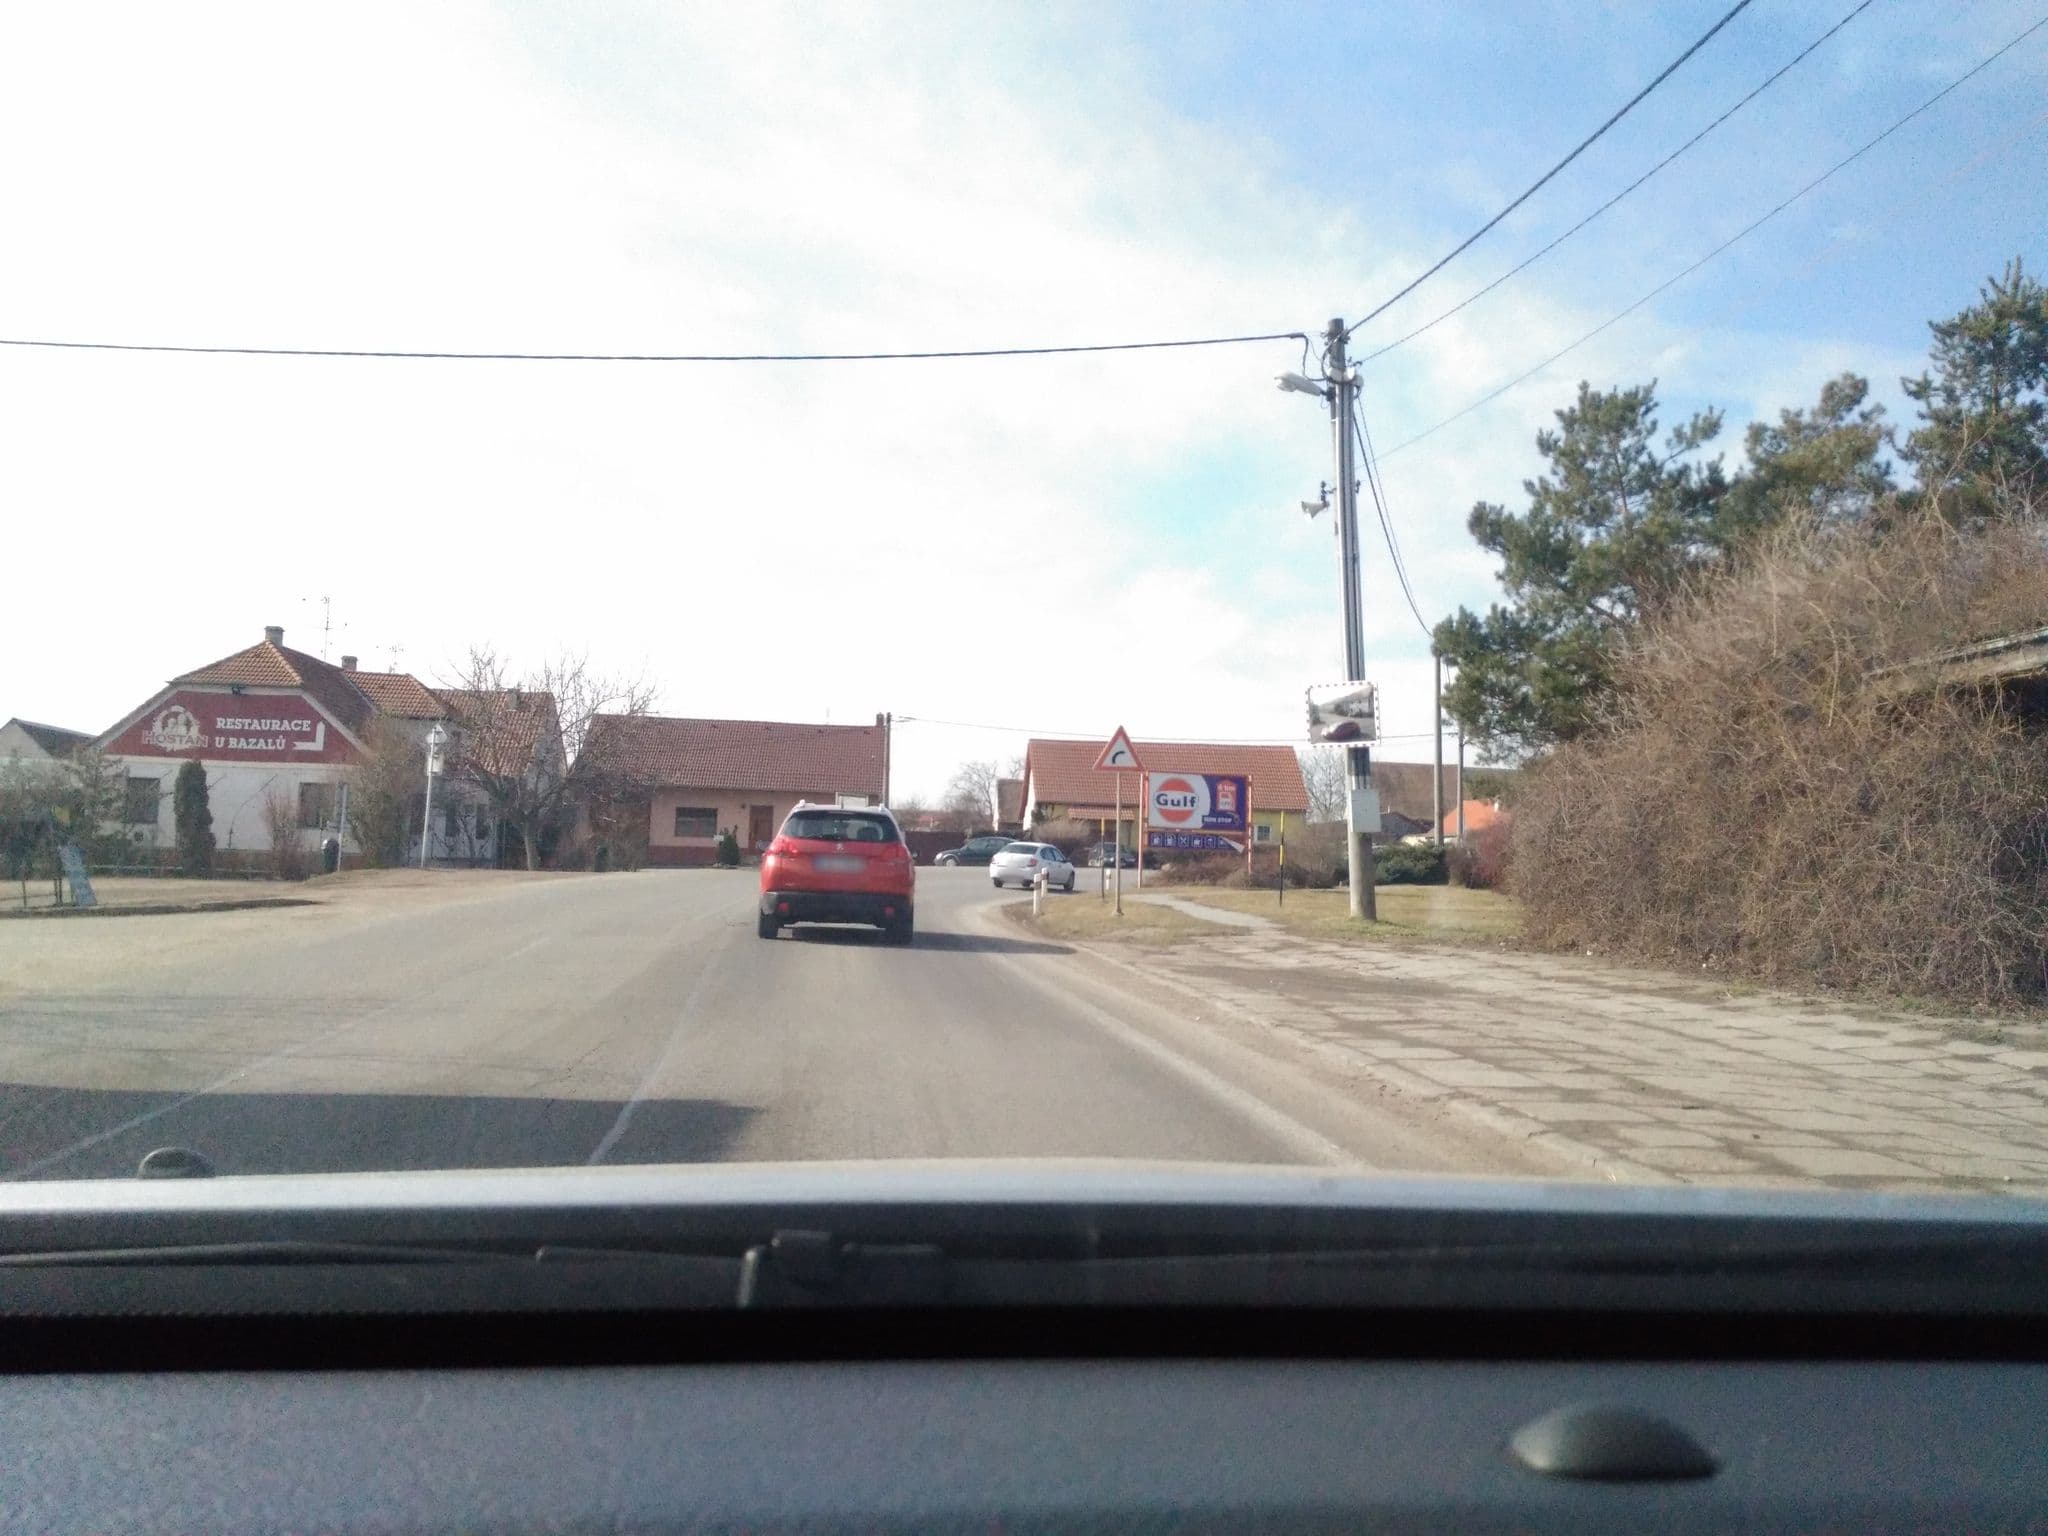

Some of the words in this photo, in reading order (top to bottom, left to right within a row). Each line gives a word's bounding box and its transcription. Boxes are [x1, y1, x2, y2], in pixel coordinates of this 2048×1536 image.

[215, 717, 311, 732] RESTAURACE
[142, 730, 208, 748] HOSTAN
[215, 737, 224, 748] U
[1156, 793, 1197, 808] Gulf
